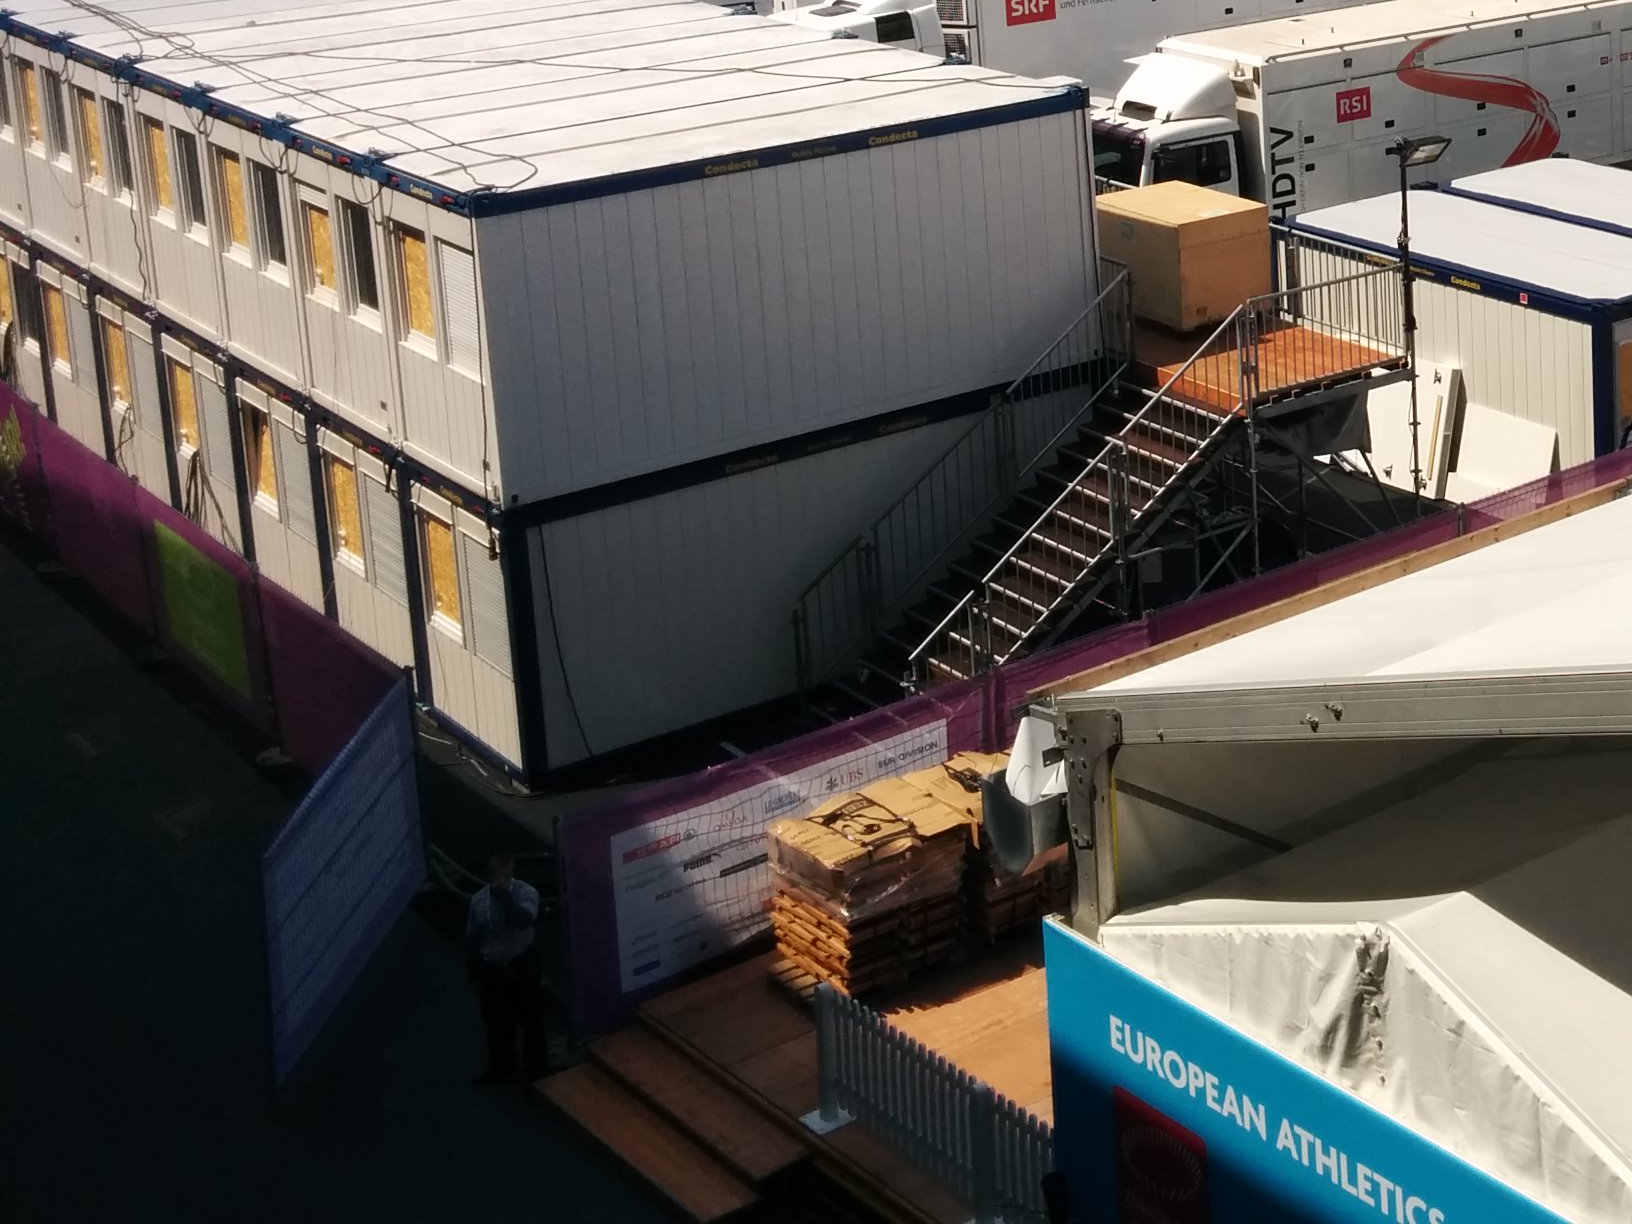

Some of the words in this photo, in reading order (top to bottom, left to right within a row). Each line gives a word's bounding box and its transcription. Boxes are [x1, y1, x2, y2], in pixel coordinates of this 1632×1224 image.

[1340, 95, 1367, 115] RSI
[869, 129, 918, 146] Condecta
[705, 159, 759, 175] Condecta
[1269, 126, 1297, 220] HDTV
[1450, 275, 1481, 290] Condecta
[1109, 1014, 1266, 1142] EUROPEAN
